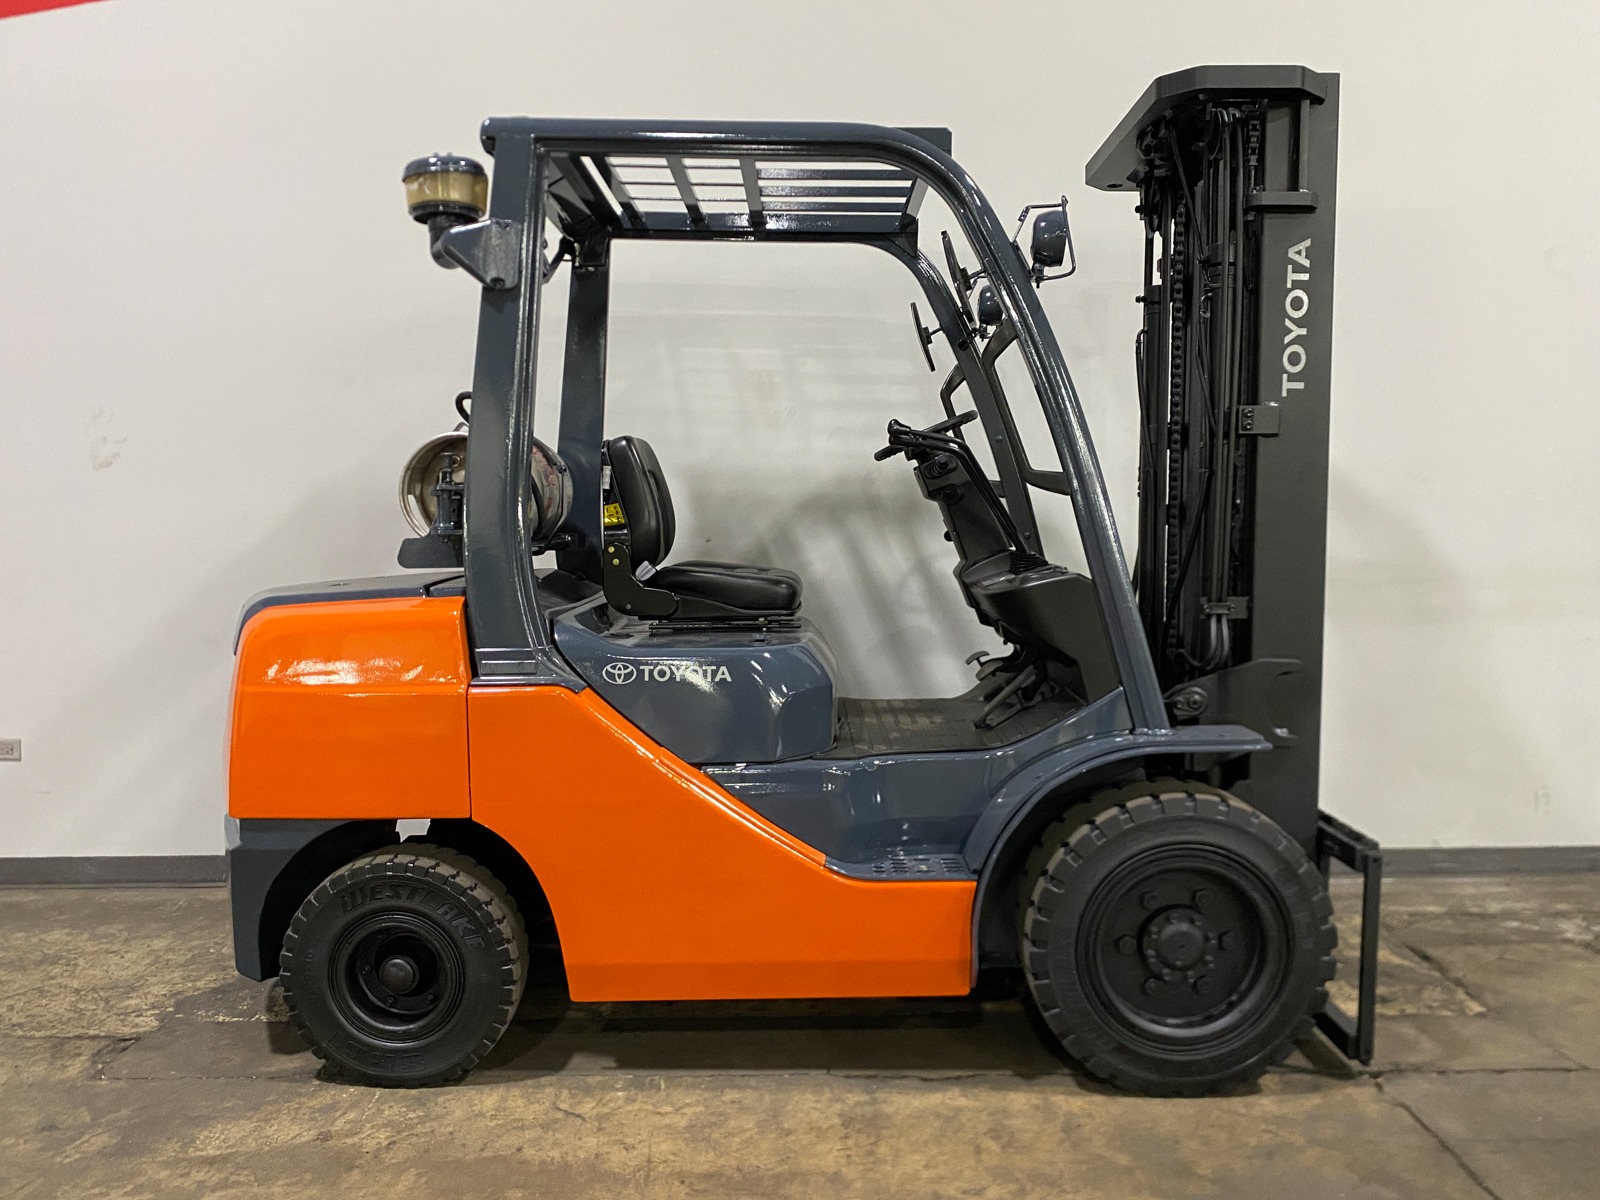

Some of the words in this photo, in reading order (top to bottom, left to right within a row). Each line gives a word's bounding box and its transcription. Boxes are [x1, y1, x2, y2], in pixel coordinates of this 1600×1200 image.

[1282, 238, 1312, 397] TOYOTA
[640, 665, 732, 682] TOYOTA
[339, 882, 486, 949] WESTLAKE
